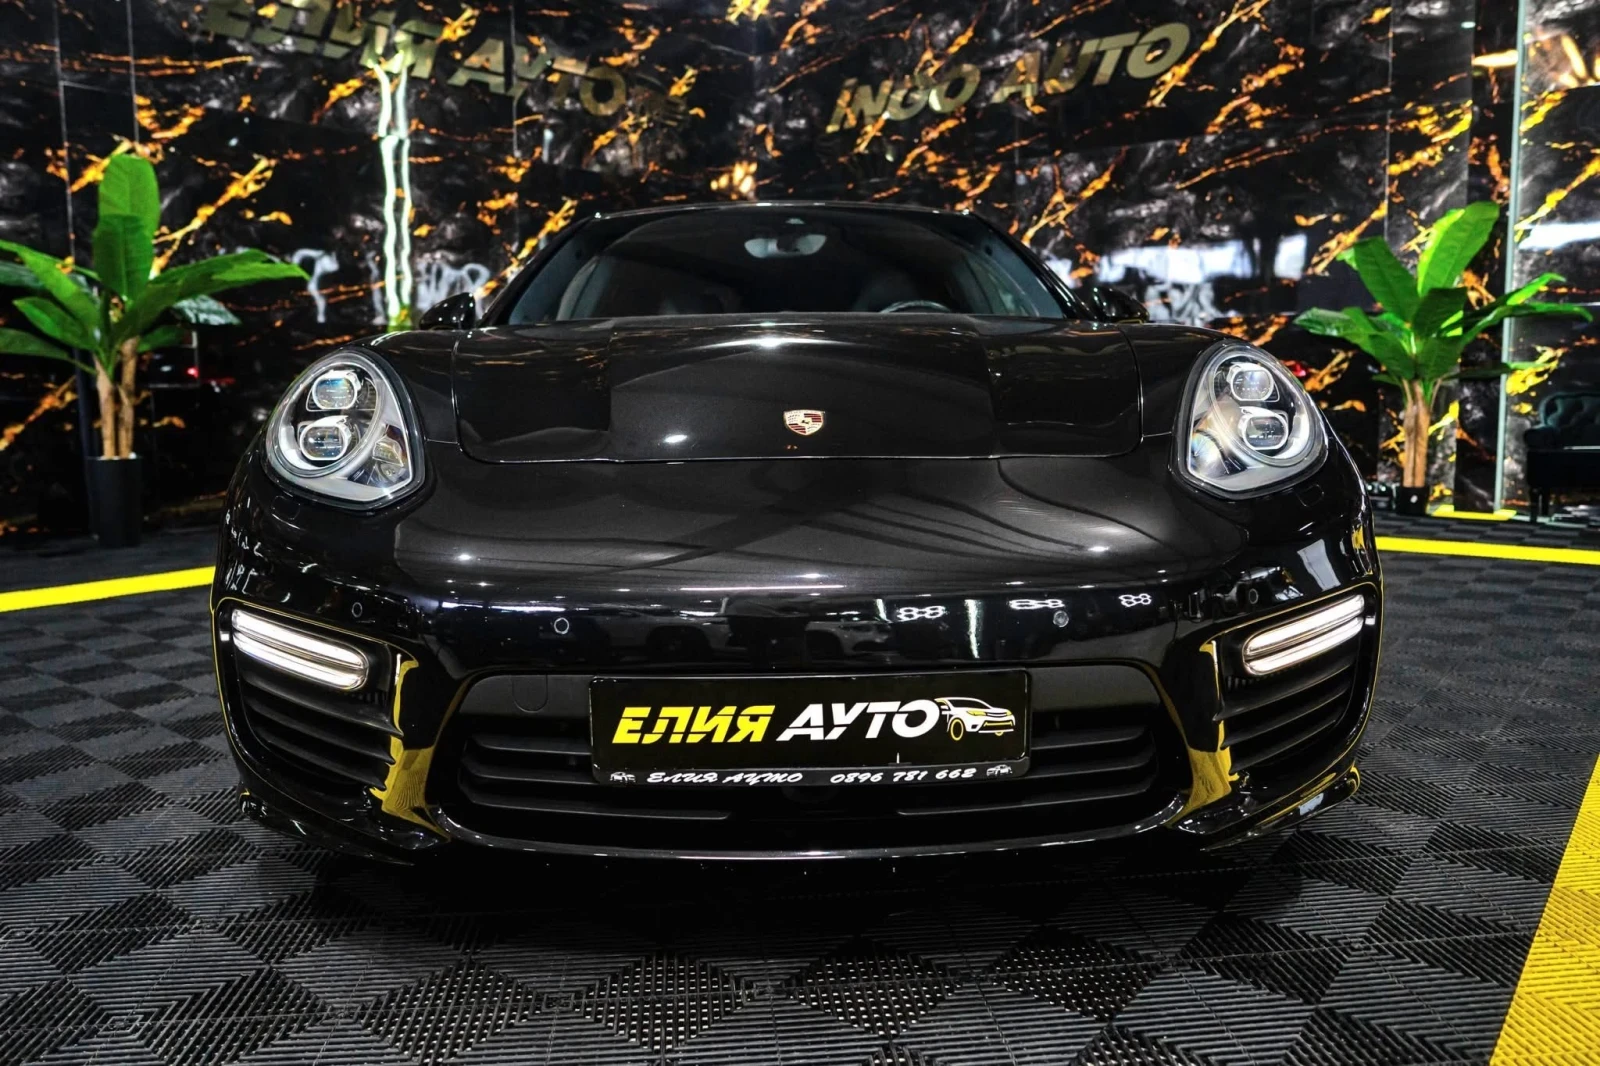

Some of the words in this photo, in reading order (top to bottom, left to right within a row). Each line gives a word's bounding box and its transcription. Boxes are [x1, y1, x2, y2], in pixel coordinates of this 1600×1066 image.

[991, 22, 1191, 104] AUTO
[612, 704, 775, 744] ЕЛИЯ
[776, 699, 940, 741] АУТО
[830, 772, 884, 784] 0896
[892, 770, 928, 782] 781
